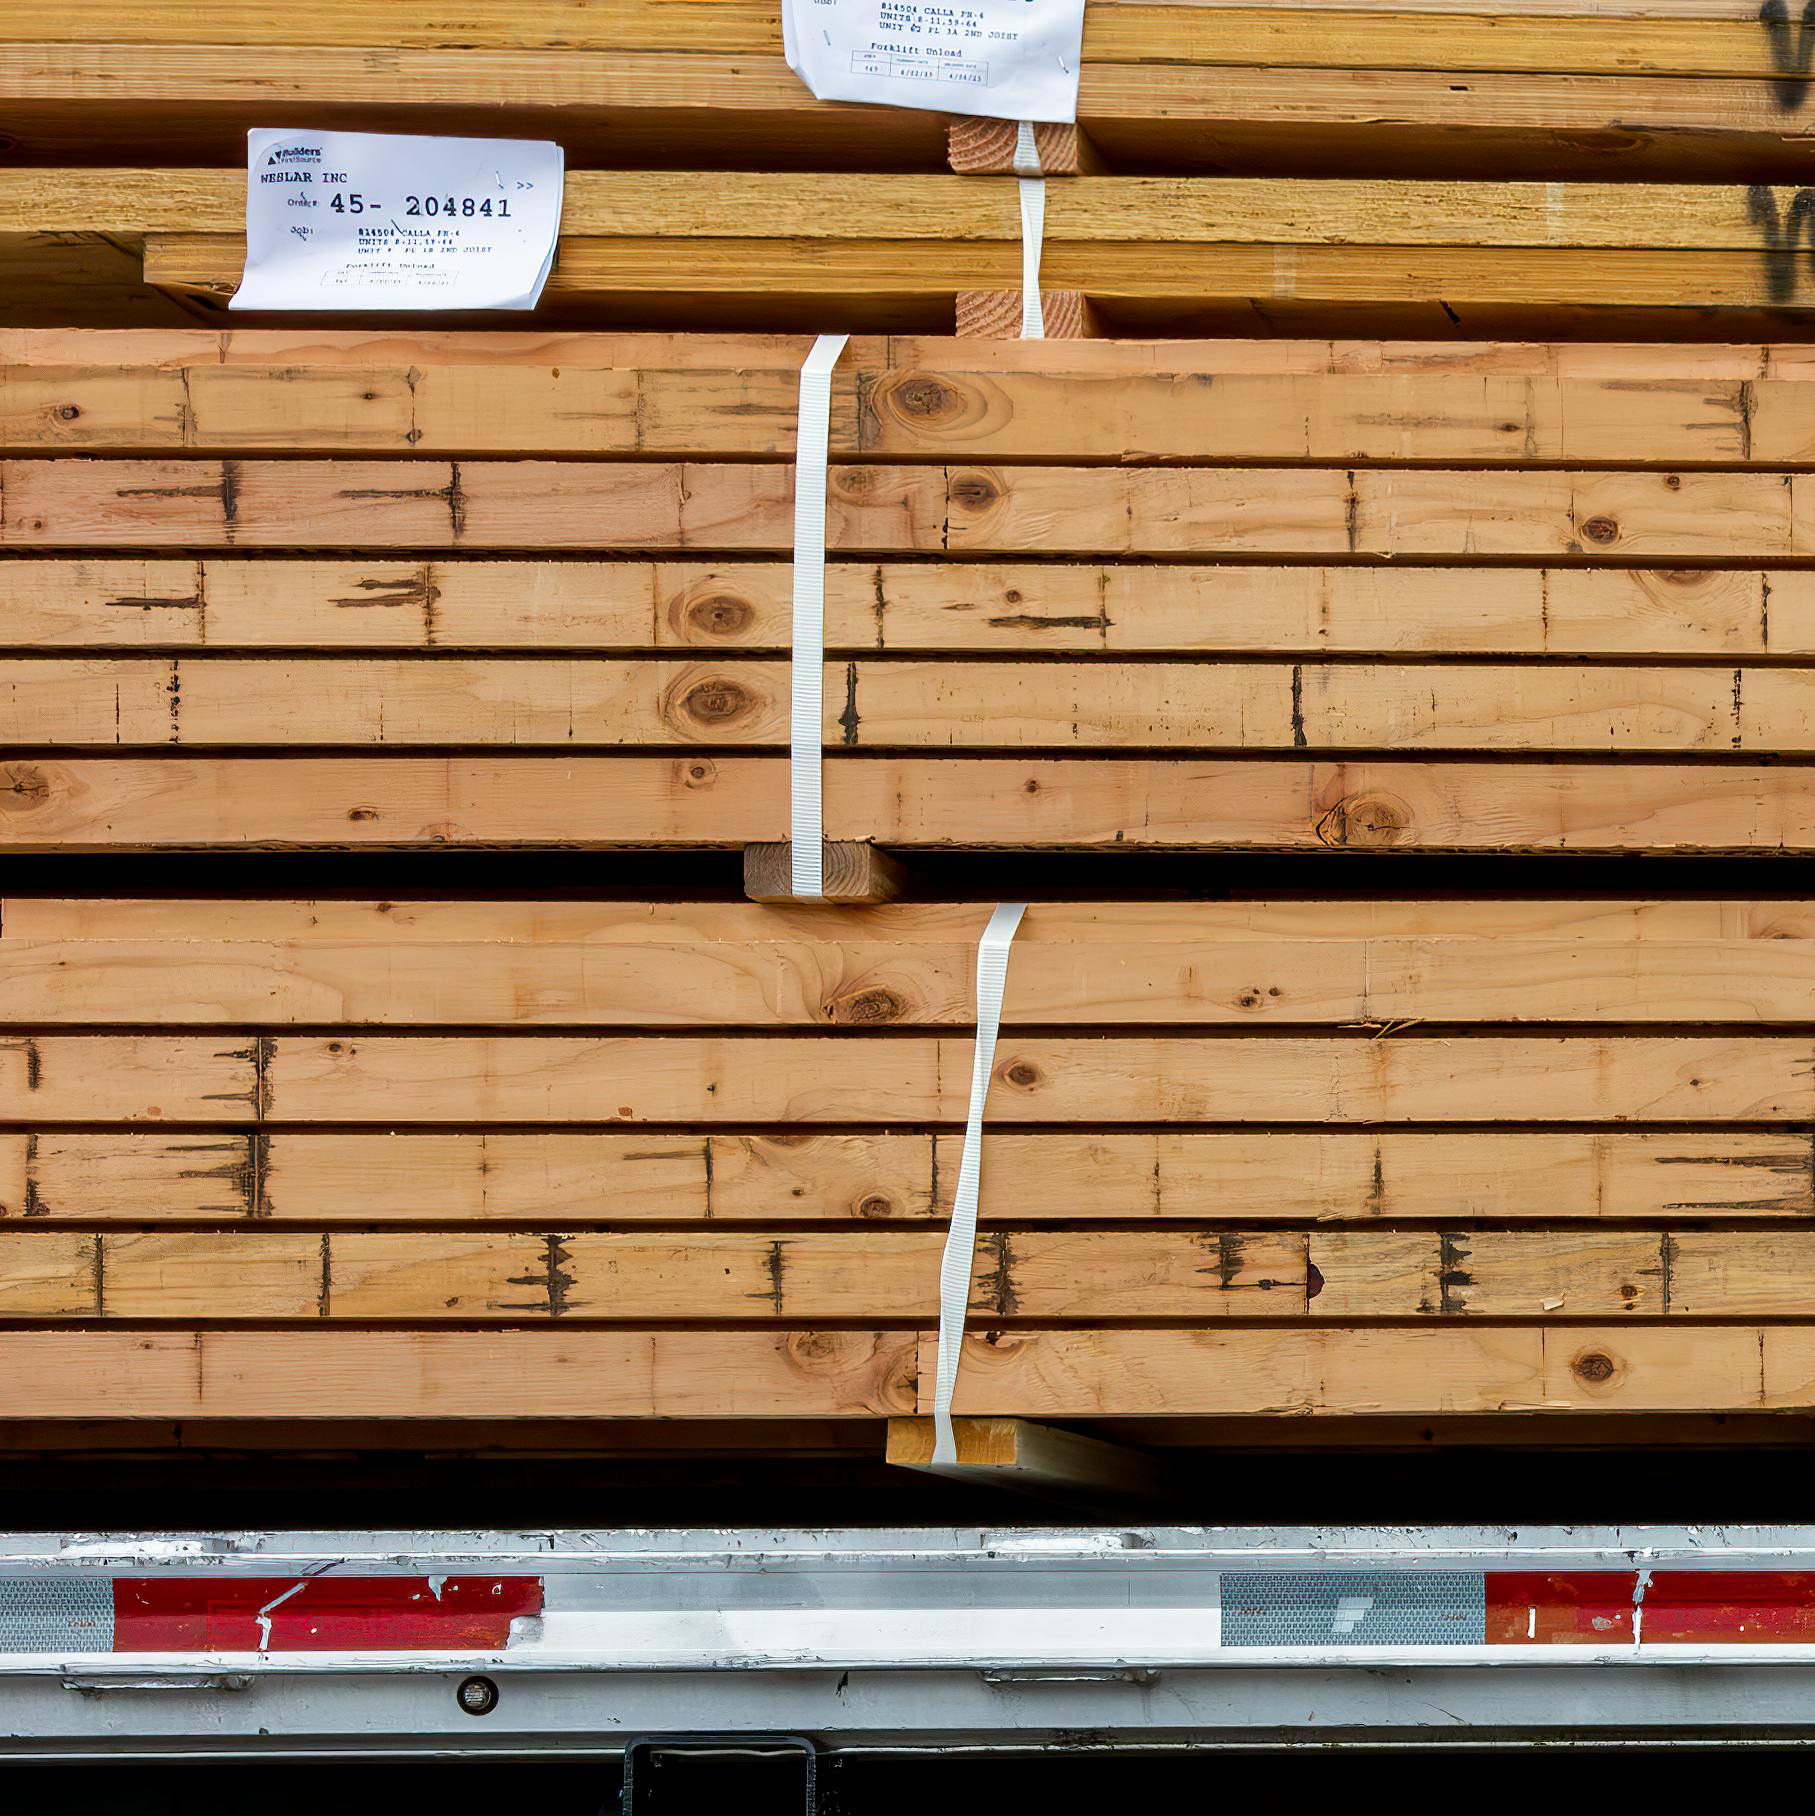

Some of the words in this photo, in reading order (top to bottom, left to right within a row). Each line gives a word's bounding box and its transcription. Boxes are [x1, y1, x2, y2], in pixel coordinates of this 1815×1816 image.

[322, 172, 348, 183] INC
[330, 192, 382, 213] 45-
[405, 195, 512, 218] 204841
